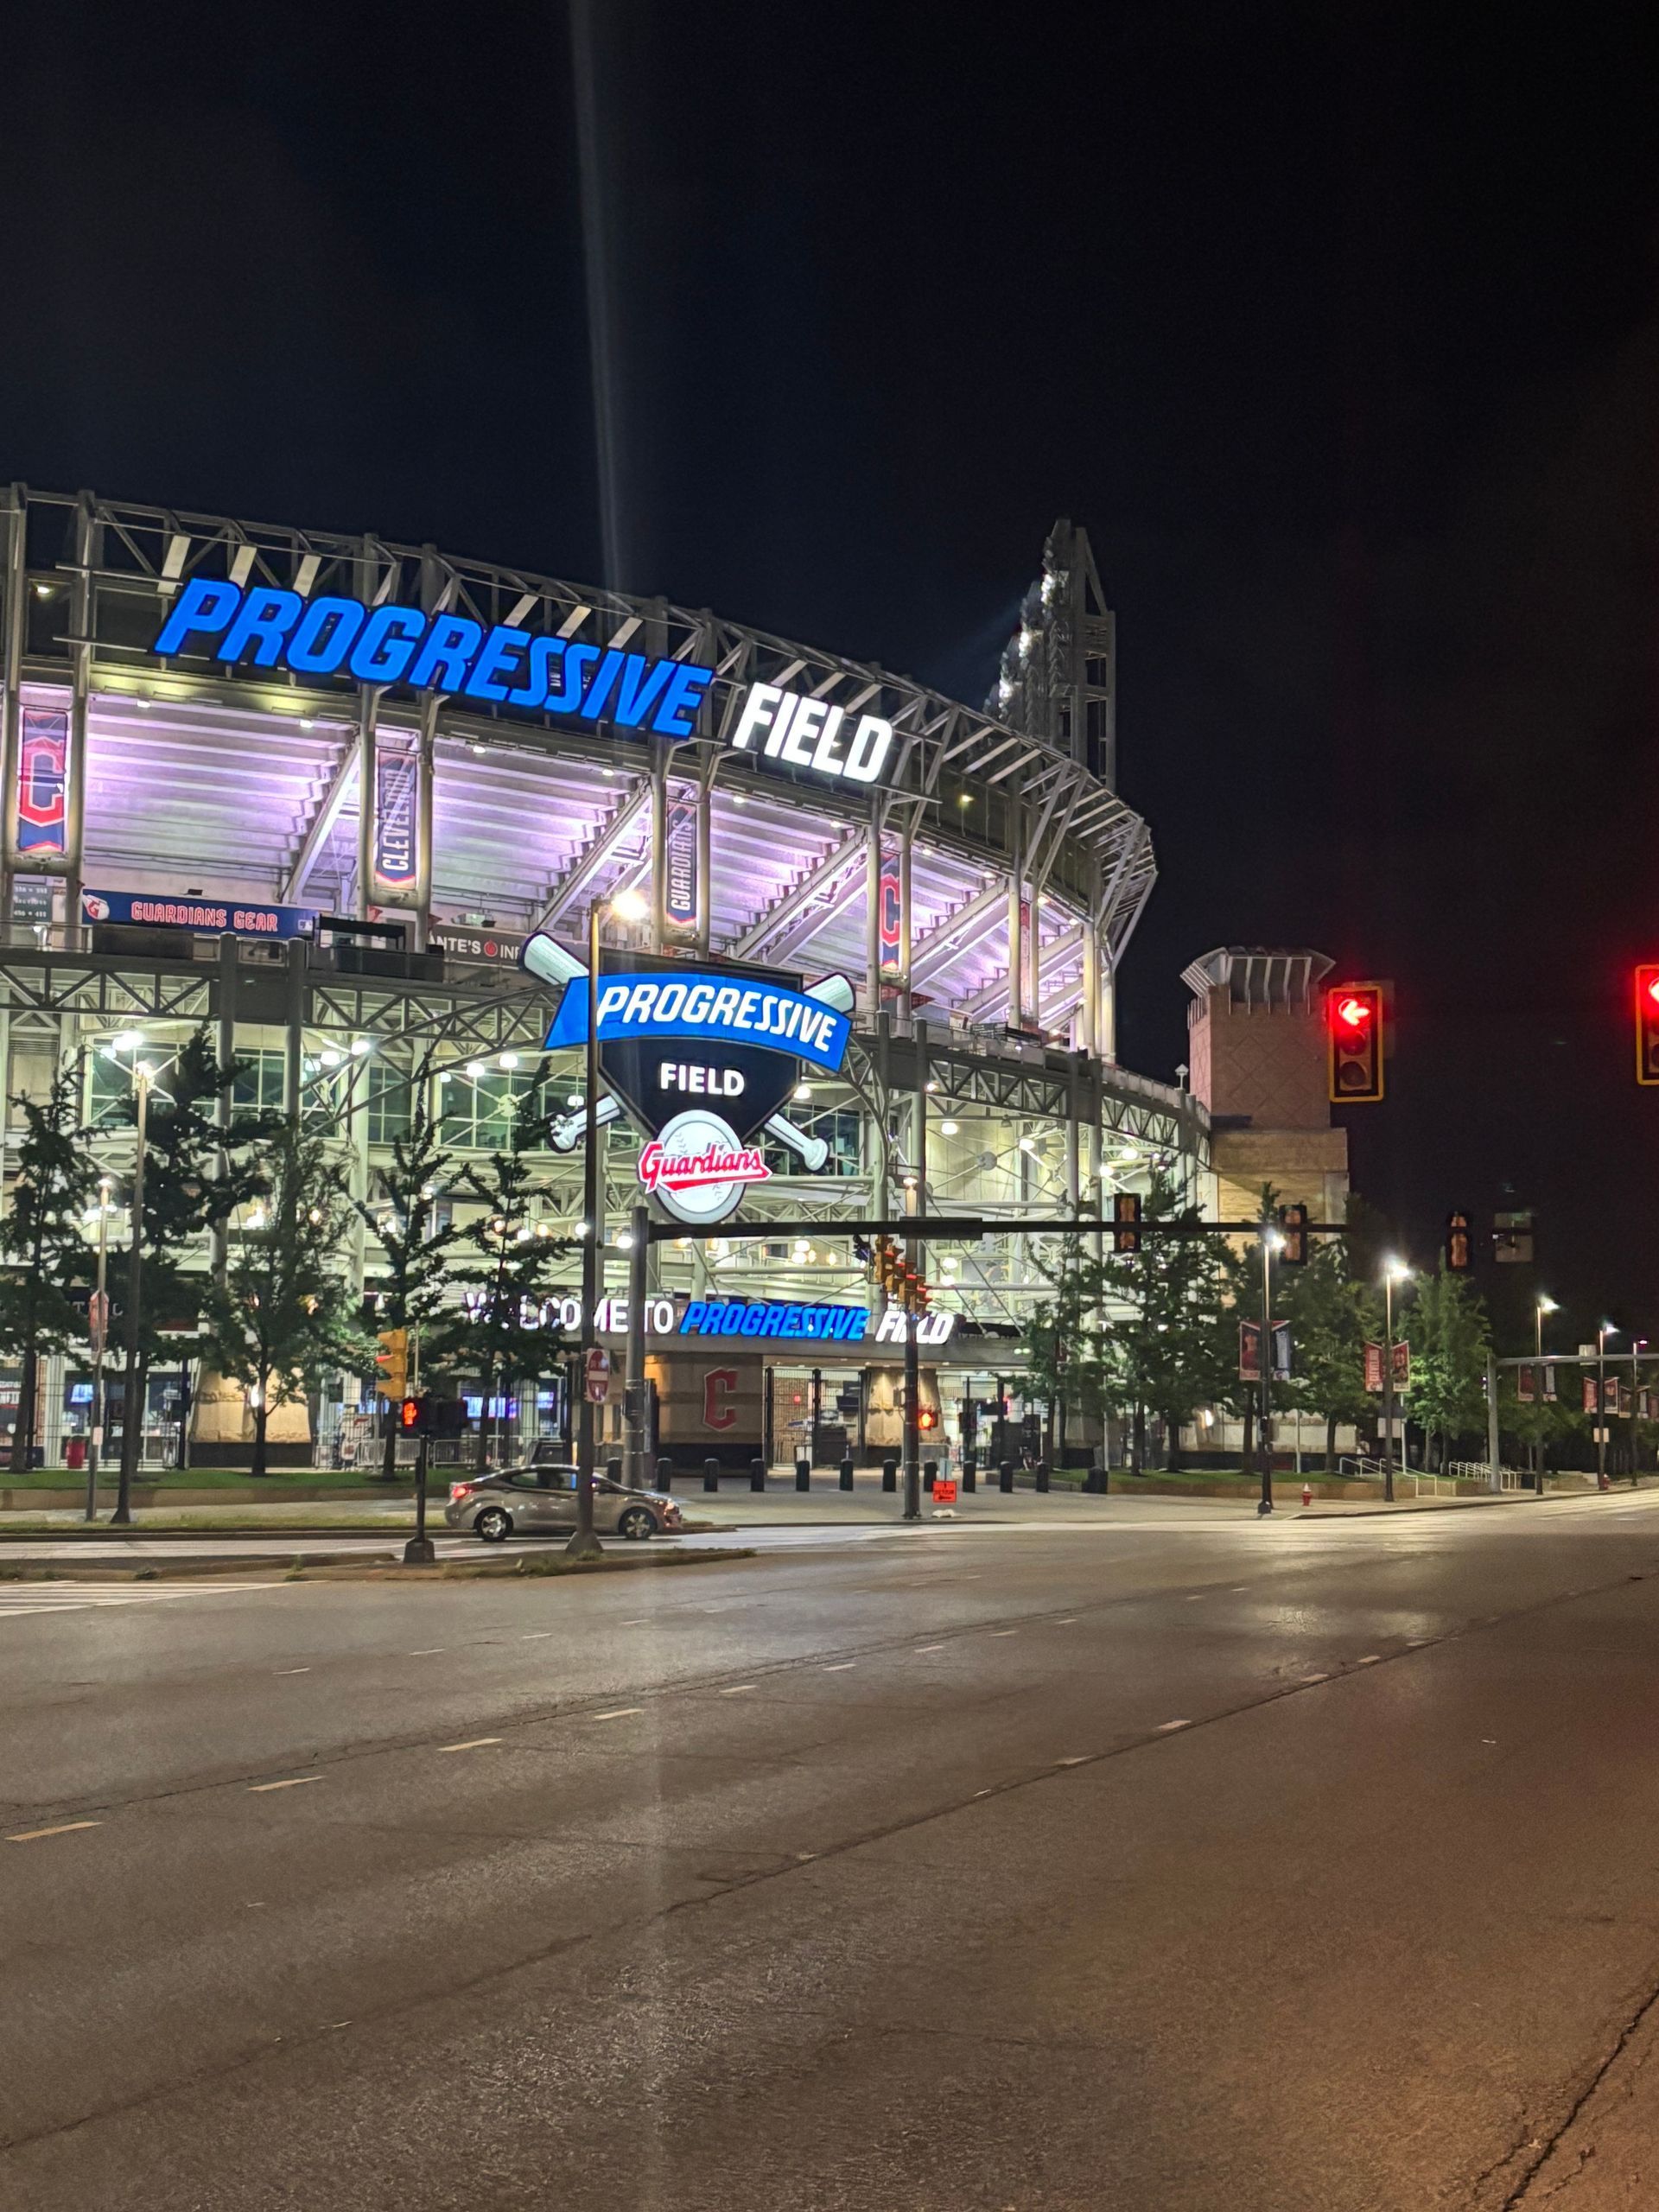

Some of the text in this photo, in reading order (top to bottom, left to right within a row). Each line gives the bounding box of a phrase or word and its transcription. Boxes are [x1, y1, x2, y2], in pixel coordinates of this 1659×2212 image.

[154, 577, 893, 783] PROGRESSIVE FIELD
[382, 769, 410, 871] CLEVELAND
[671, 819, 692, 911] GUARDIANS
[130, 901, 278, 932] GUARDIANS GEAR
[428, 932, 481, 955] ANTE'S
[597, 983, 836, 1052] PROGRESSIVE
[660, 1062, 745, 1096] FIELD
[639, 1141, 772, 1193] Guardians
[679, 1301, 870, 1340] PROGRESSIVE
[702, 1367, 739, 1432] C
